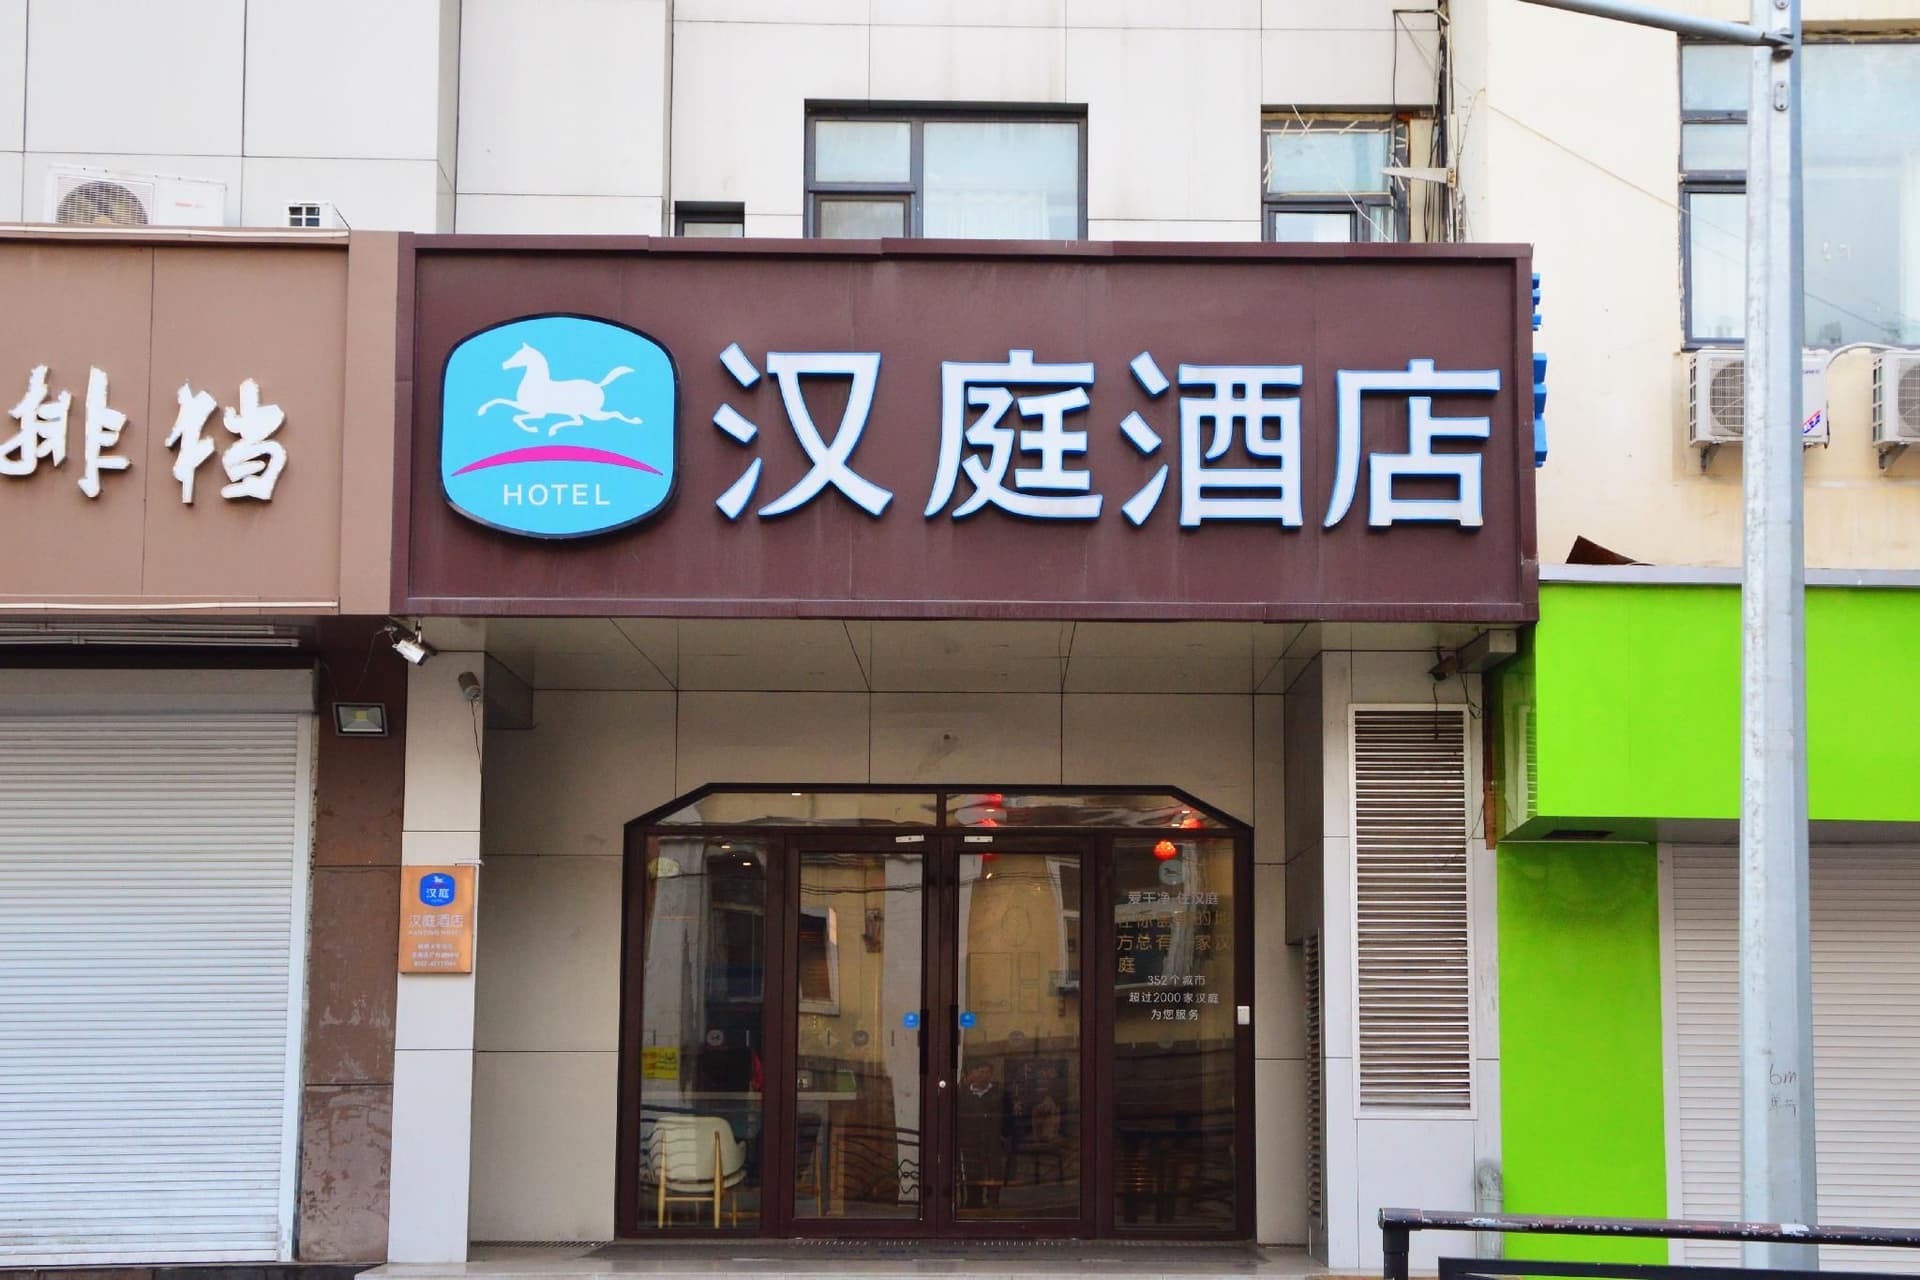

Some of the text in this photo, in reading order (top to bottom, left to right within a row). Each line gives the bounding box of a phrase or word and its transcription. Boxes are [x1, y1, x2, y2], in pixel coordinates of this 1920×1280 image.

[713, 344, 1501, 528] 汉庭酒店
[503, 483, 611, 506] HOTEL
[425, 887, 450, 899] 汉庭
[1127, 890, 1171, 905] 爱干净
[1118, 956, 1137, 974] 庭
[1150, 1008, 1200, 1021] 为您服务
